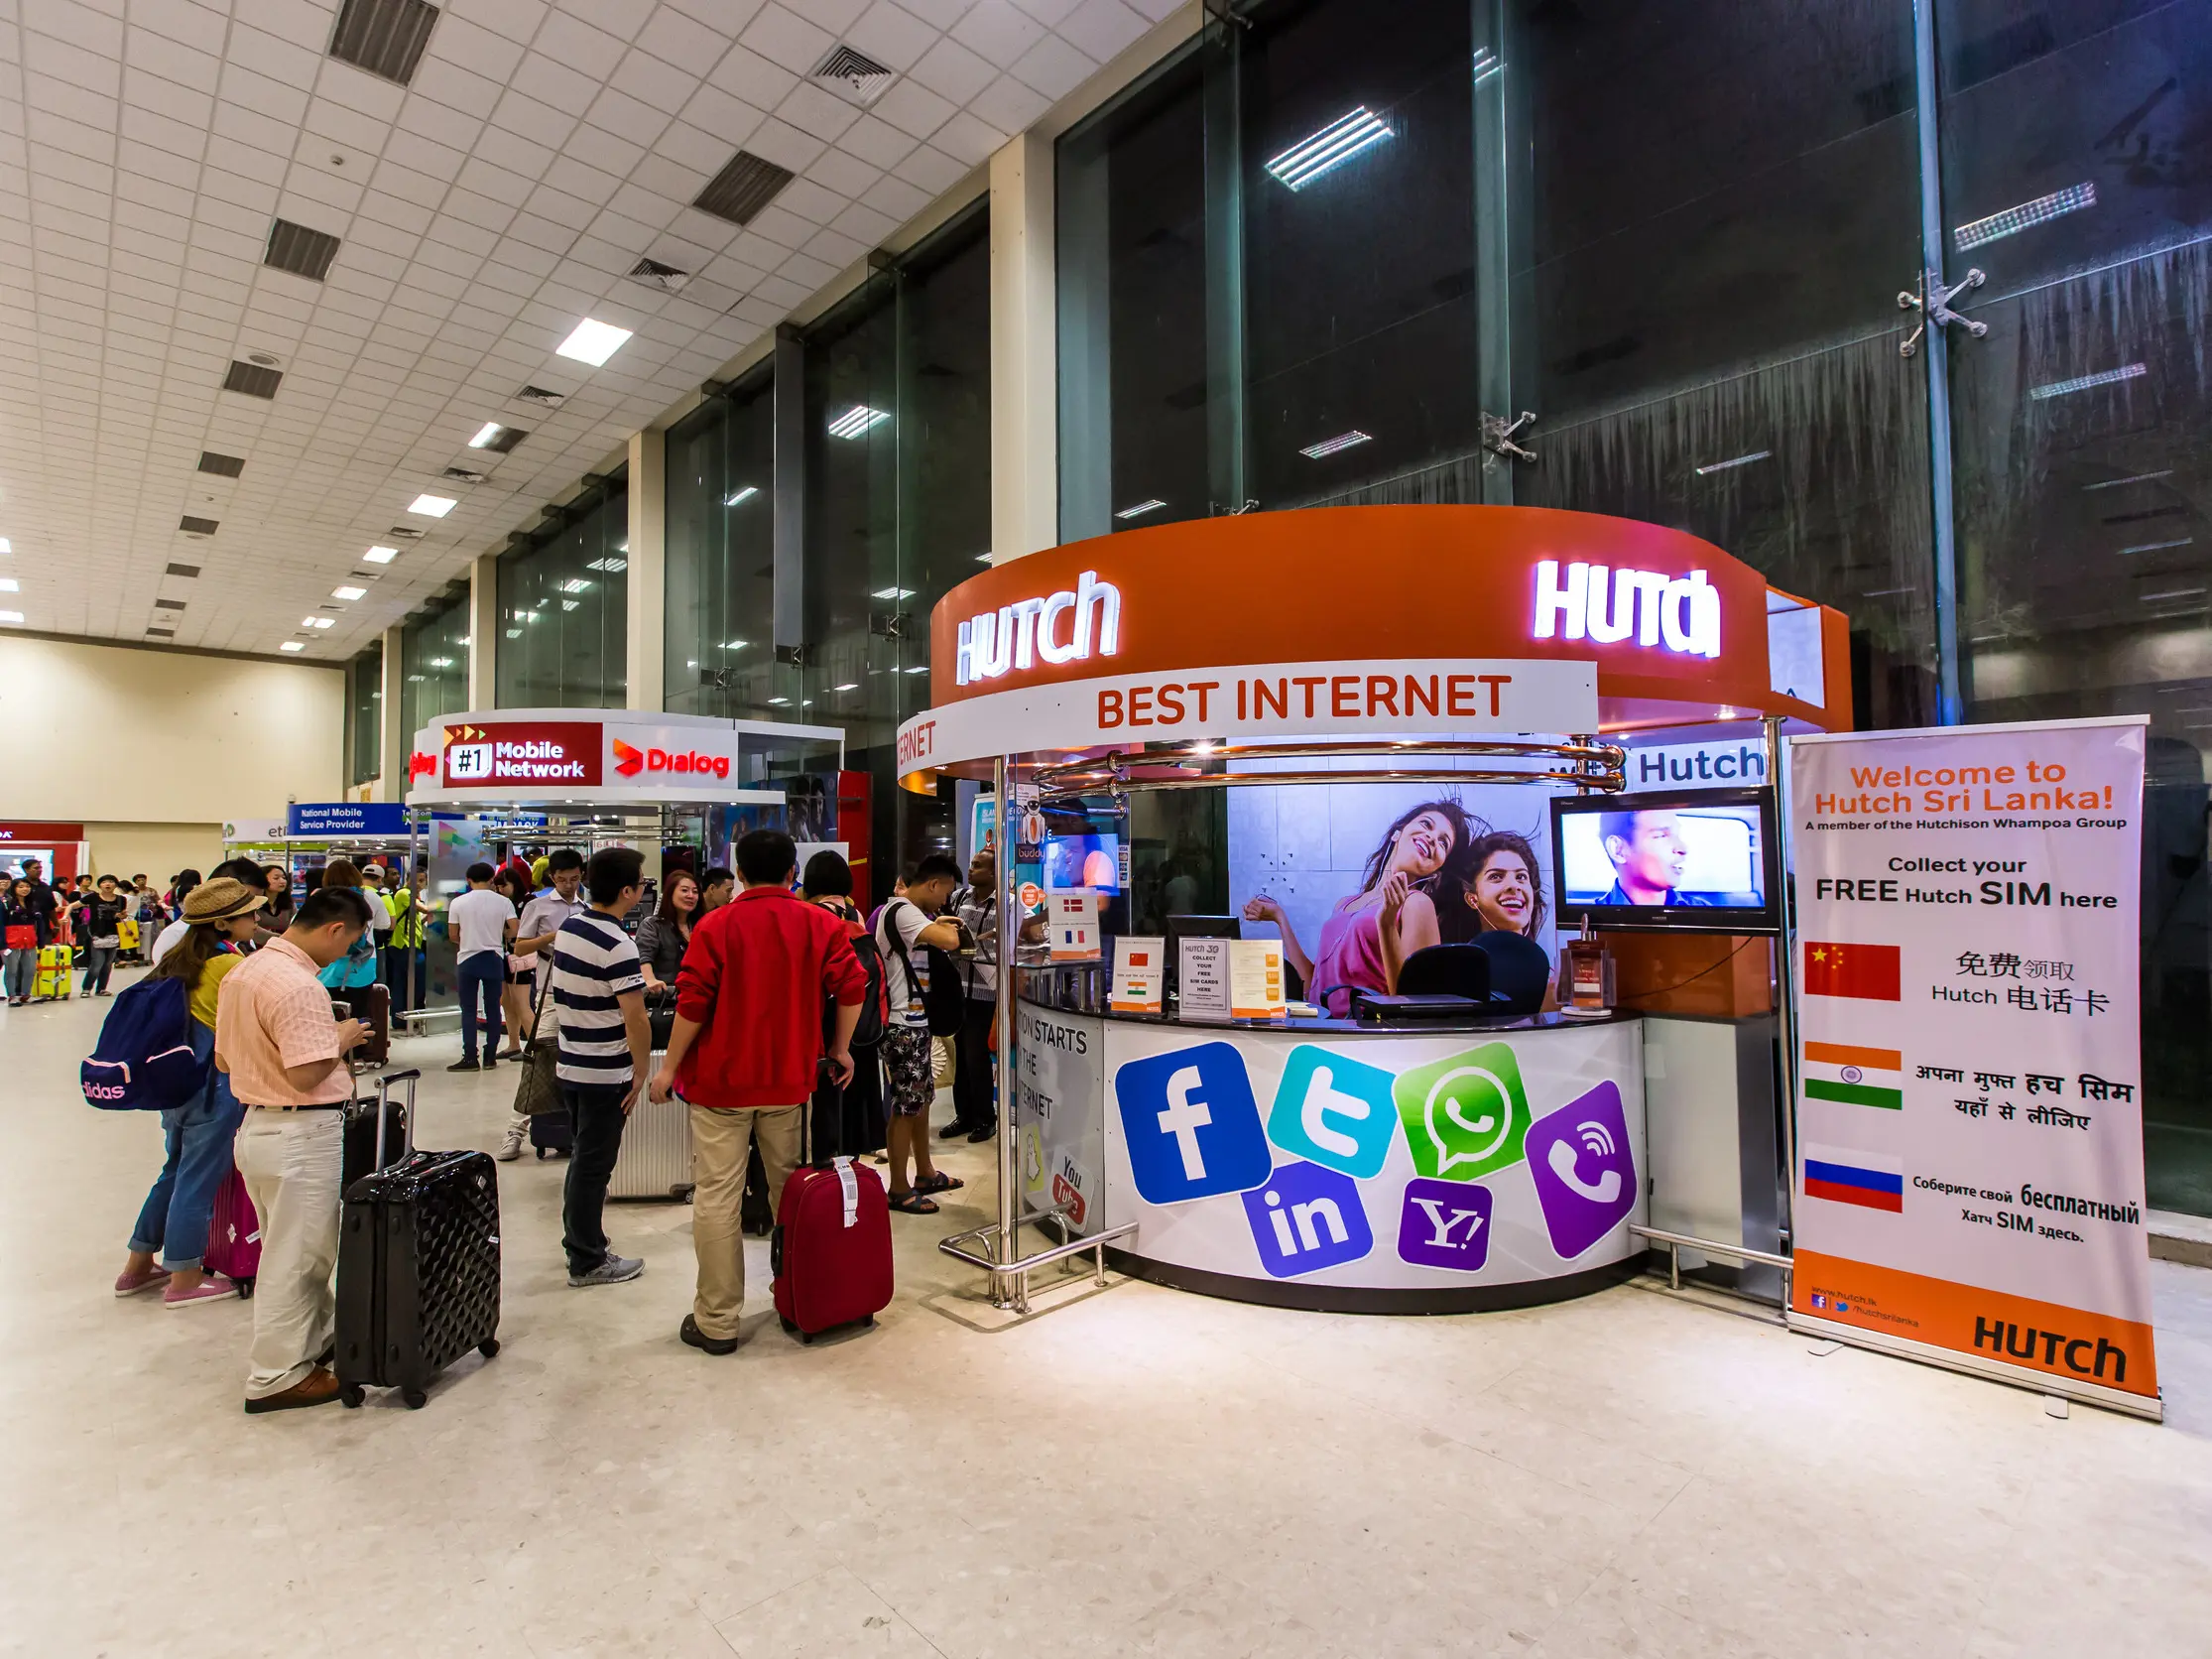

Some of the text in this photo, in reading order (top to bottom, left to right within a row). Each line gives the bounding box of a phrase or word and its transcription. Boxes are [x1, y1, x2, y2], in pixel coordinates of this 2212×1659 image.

[1097, 675, 1513, 729] BEST INTERNET
[458, 749, 481, 772] #1
[496, 741, 563, 759] Mobile
[648, 748, 729, 779] Dialog
[1641, 747, 1765, 783] Hutch
[496, 759, 585, 778] Network
[1851, 761, 2066, 788] Welcome to
[301, 809, 330, 818] National
[1815, 786, 2113, 815] Hutch Sri Lanka!
[300, 820, 365, 830] Service Provider
[1805, 818, 2128, 830] A member of the Hutchison Whampoa Group
[1889, 857, 2028, 876] Collect your
[1816, 879, 2118, 908] FREE Hutch SIM here
[1955, 951, 2075, 981] 免费领取
[1932, 985, 2111, 1016] Hutch 电话卡
[1035, 1019, 1087, 1055] STARTS
[1023, 1047, 1037, 1077] THE
[1915, 1065, 1964, 1084] अपना
[2026, 1073, 2065, 1095] हच
[2078, 1074, 2135, 1103] सिम
[1157, 1065, 1213, 1181] f
[1998, 1101, 2017, 1120] से
[2027, 1106, 2092, 1131] लीजिए
[1064, 1156, 1082, 1190] You
[1912, 1176, 2140, 1225] Соберите свой бесплатный
[1264, 1191, 1347, 1258] in
[1411, 1197, 1485, 1250] Y!
[1961, 1209, 2085, 1242] Хатч SIM здесь.
[1812, 1286, 1877, 1306] www.hutch.lk
